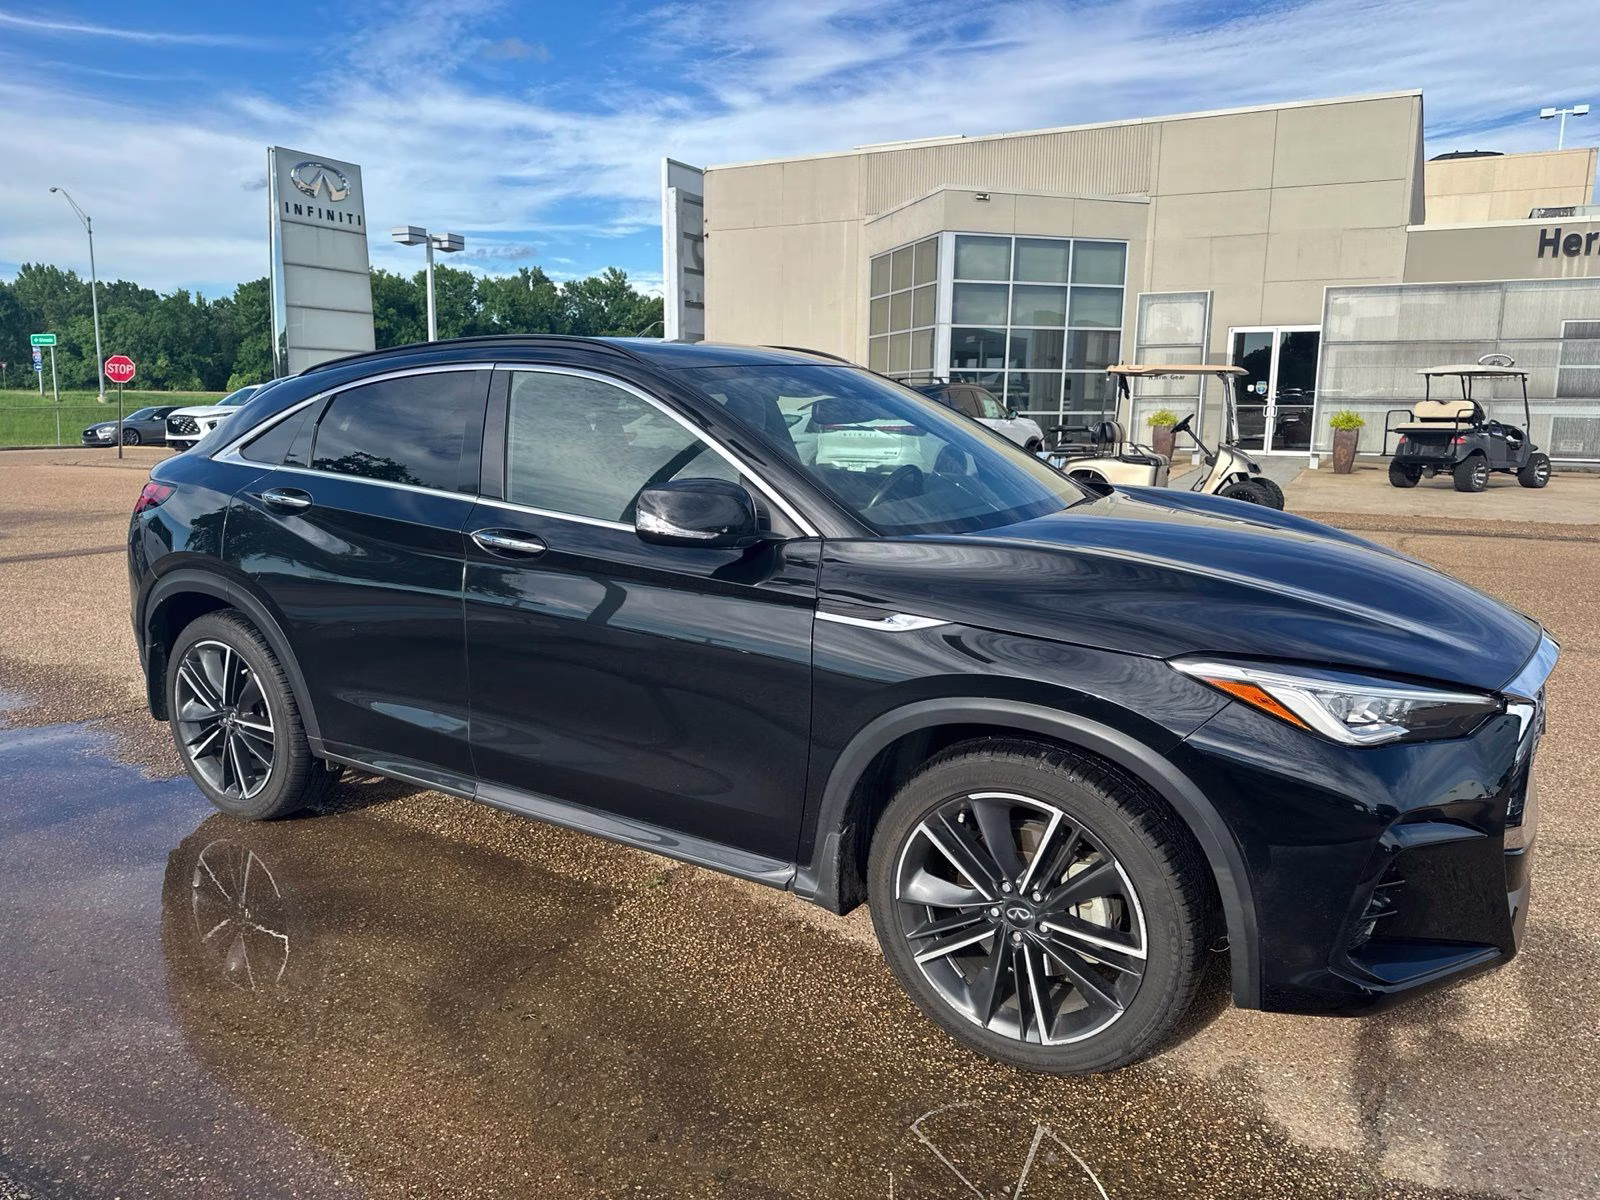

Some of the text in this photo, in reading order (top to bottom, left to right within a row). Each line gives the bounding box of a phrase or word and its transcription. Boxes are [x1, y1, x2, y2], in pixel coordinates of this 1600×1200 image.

[285, 202, 361, 226] INFINITI
[1537, 227, 1600, 258] Her
[107, 363, 133, 374] STOP
